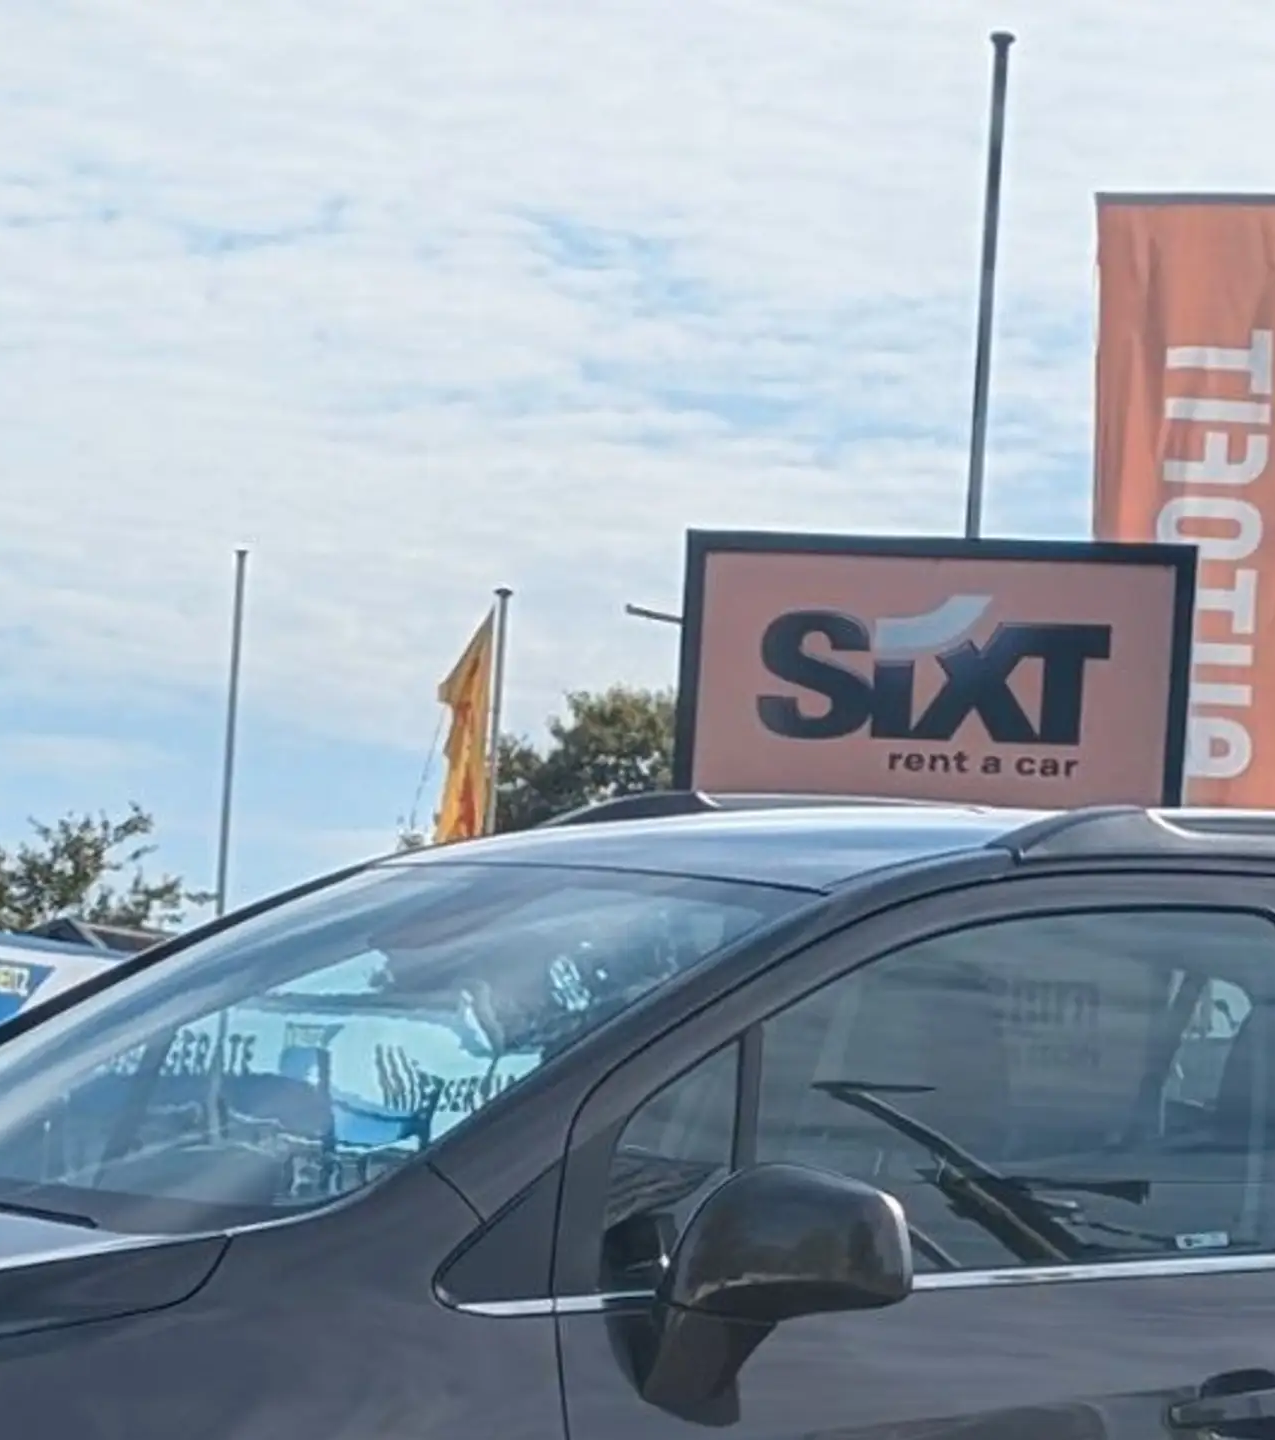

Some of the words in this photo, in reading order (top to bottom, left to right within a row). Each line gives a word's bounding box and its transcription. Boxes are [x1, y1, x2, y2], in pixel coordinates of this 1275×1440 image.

[888, 751, 969, 773] rent
[980, 756, 1001, 774] a
[1015, 756, 1079, 777] car
